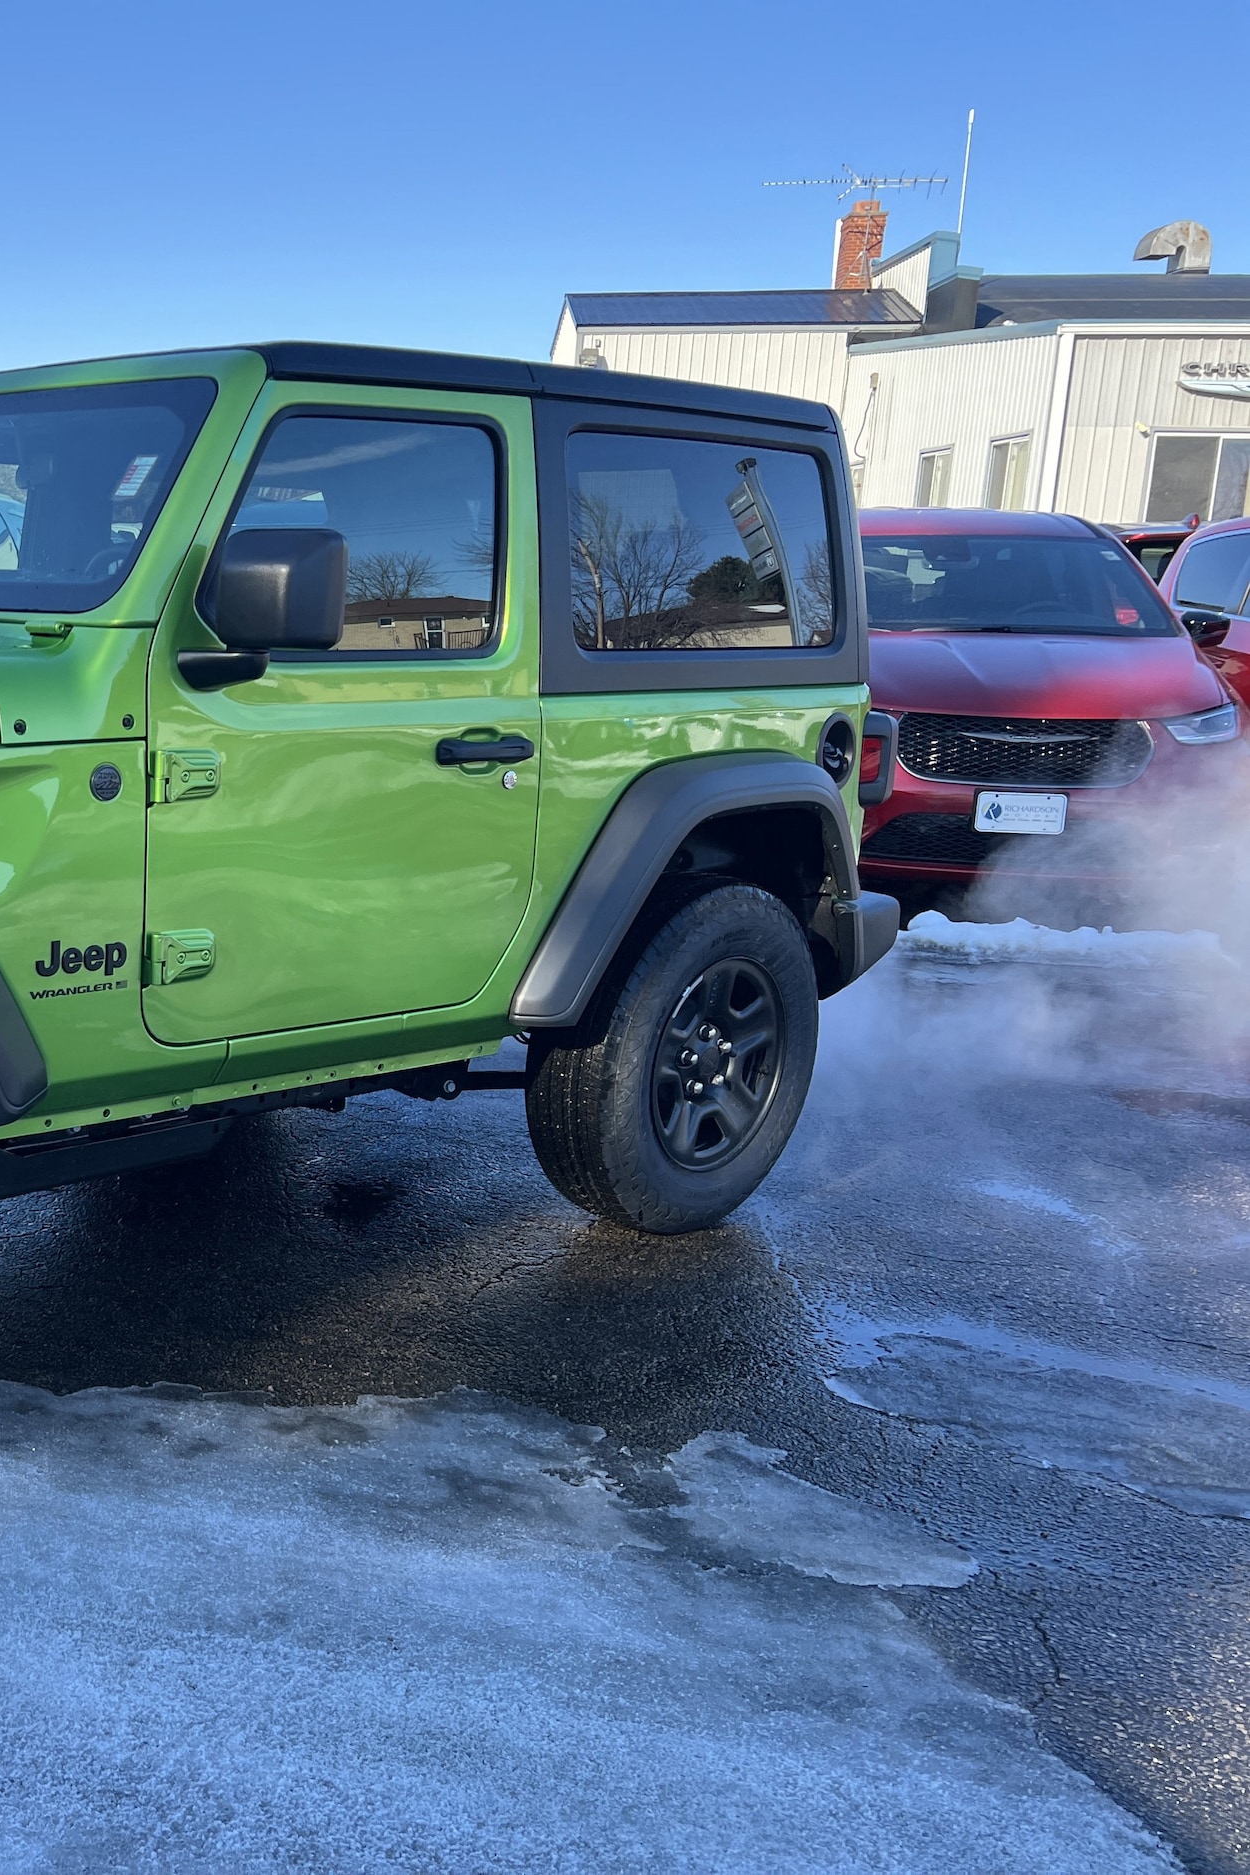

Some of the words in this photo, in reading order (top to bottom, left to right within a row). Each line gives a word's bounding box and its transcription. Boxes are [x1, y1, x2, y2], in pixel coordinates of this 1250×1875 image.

[1004, 805, 1059, 813] RICHARDSON
[35, 940, 127, 977] Jeep
[30, 982, 113, 1000] WRANGLER
